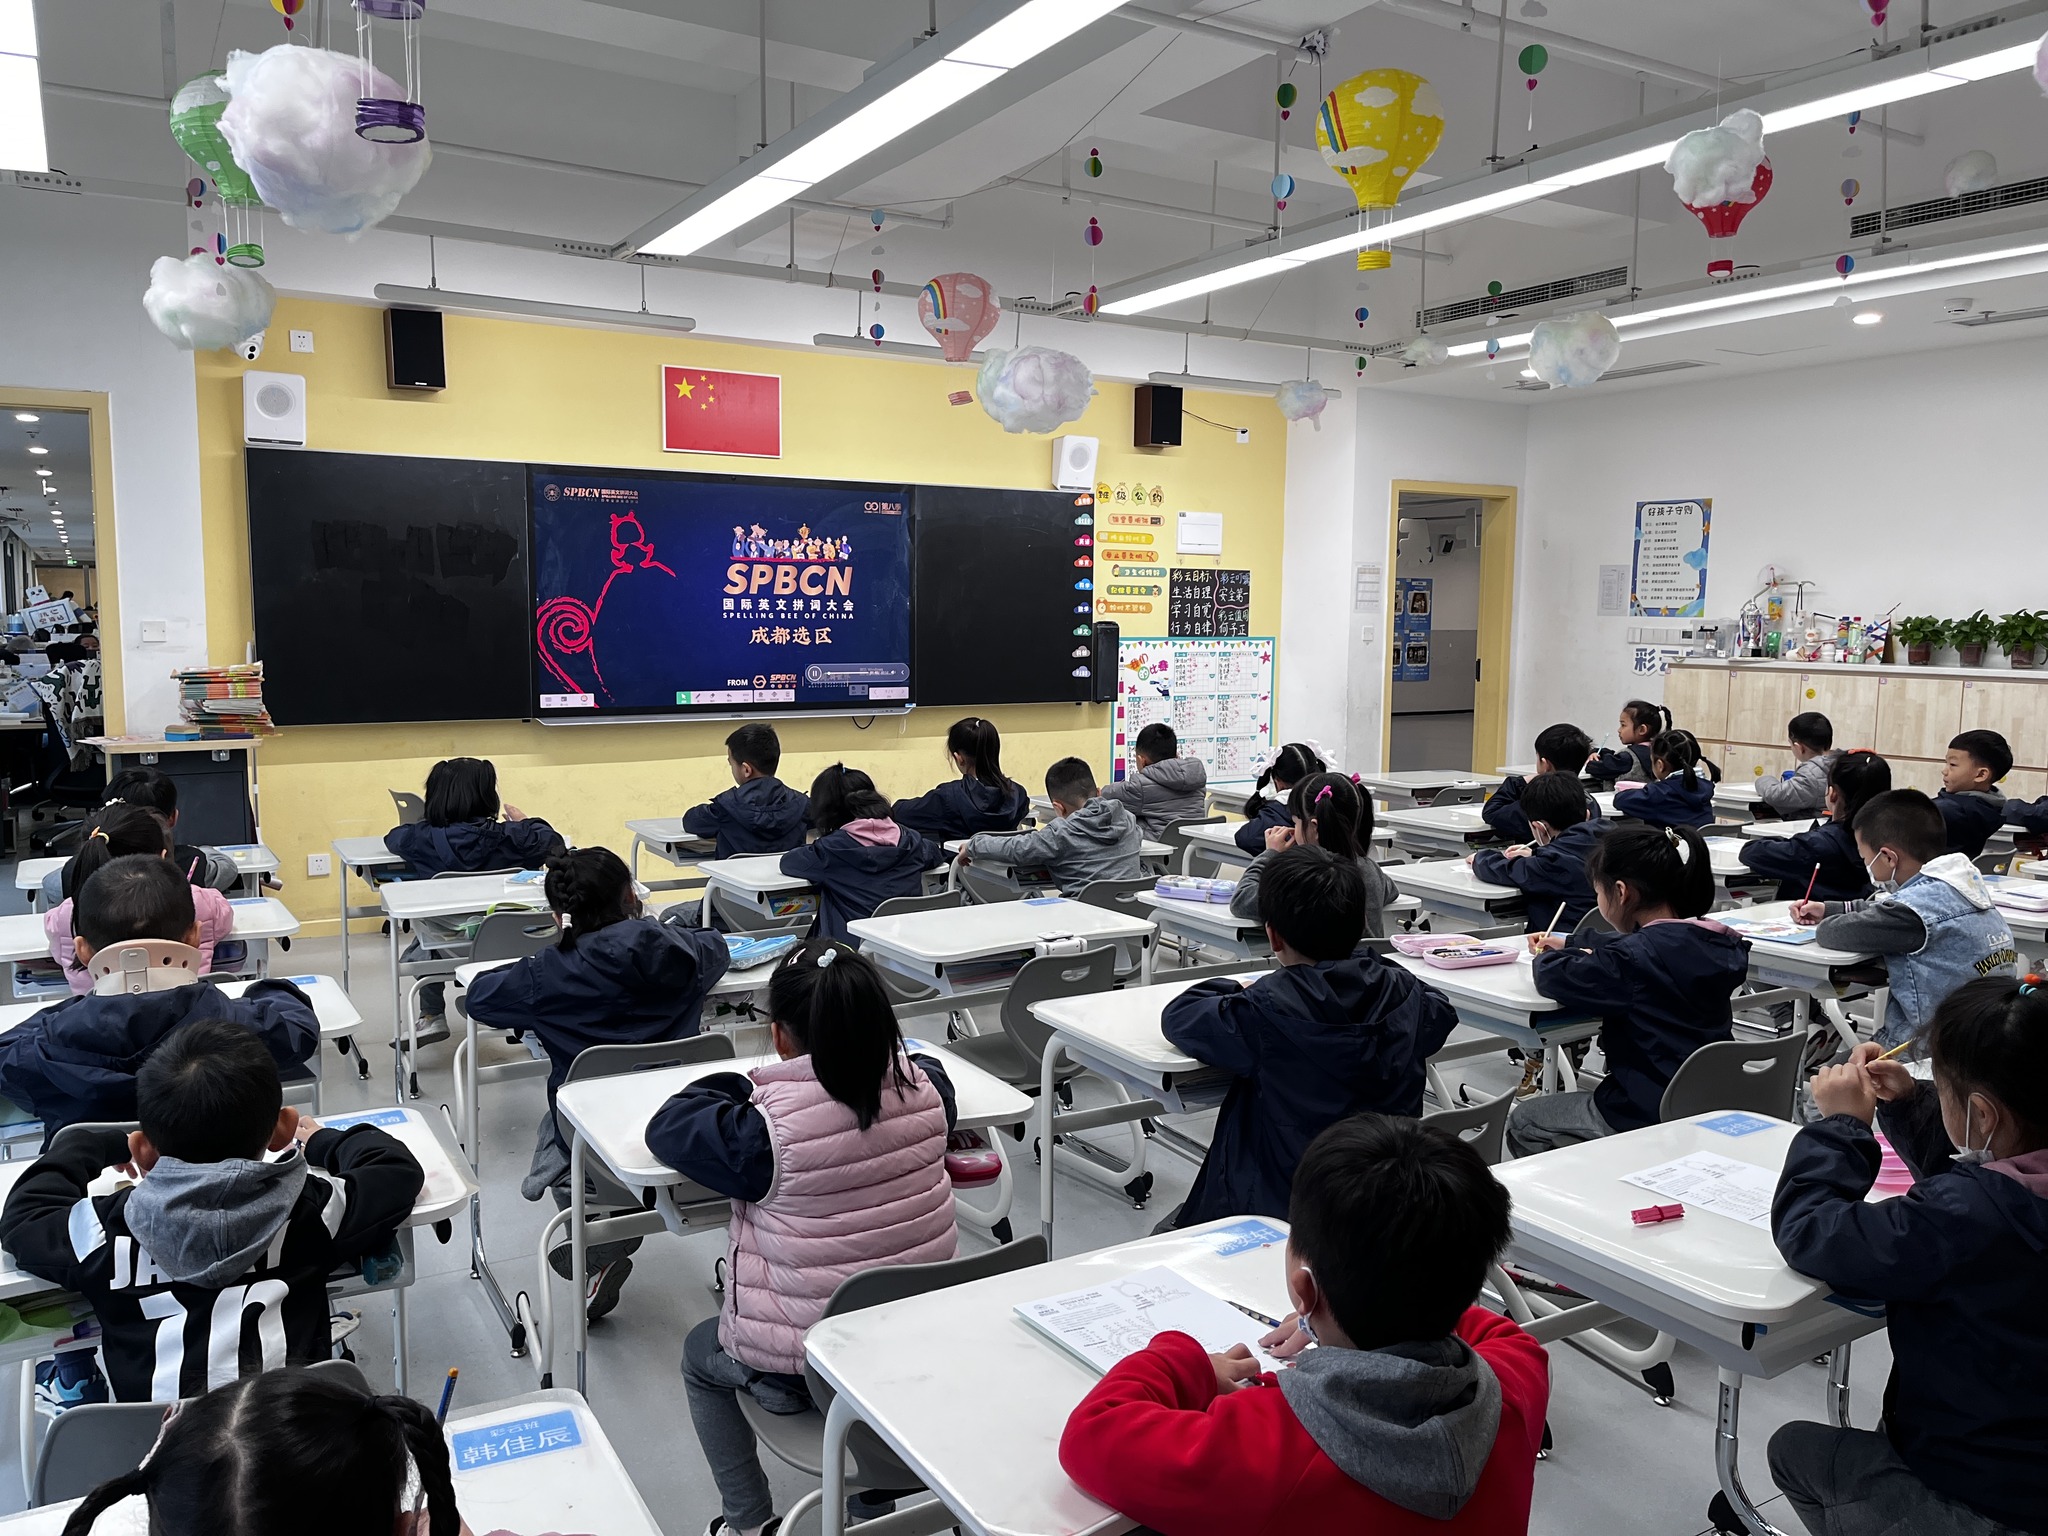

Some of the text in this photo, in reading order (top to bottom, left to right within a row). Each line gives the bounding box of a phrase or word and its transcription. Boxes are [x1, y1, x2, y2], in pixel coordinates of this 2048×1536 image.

[563, 487, 600, 498] SPBCN
[1098, 490, 1162, 503] 班级公约
[1648, 505, 1693, 516] 好孩子守则
[723, 563, 853, 596] SPBCN
[1171, 569, 1212, 583] 彩云目标
[1171, 585, 1213, 599] 生活自理
[1219, 586, 1249, 603] 安全第一
[723, 598, 855, 611] 国际英文拼词大会
[1170, 600, 1212, 619] 学习自觉
[749, 626, 833, 645] 成都选区
[1170, 620, 1213, 636] 行为自律
[490, 1420, 540, 1438] 彩云班
[461, 1426, 573, 1464] 韩佳辰
